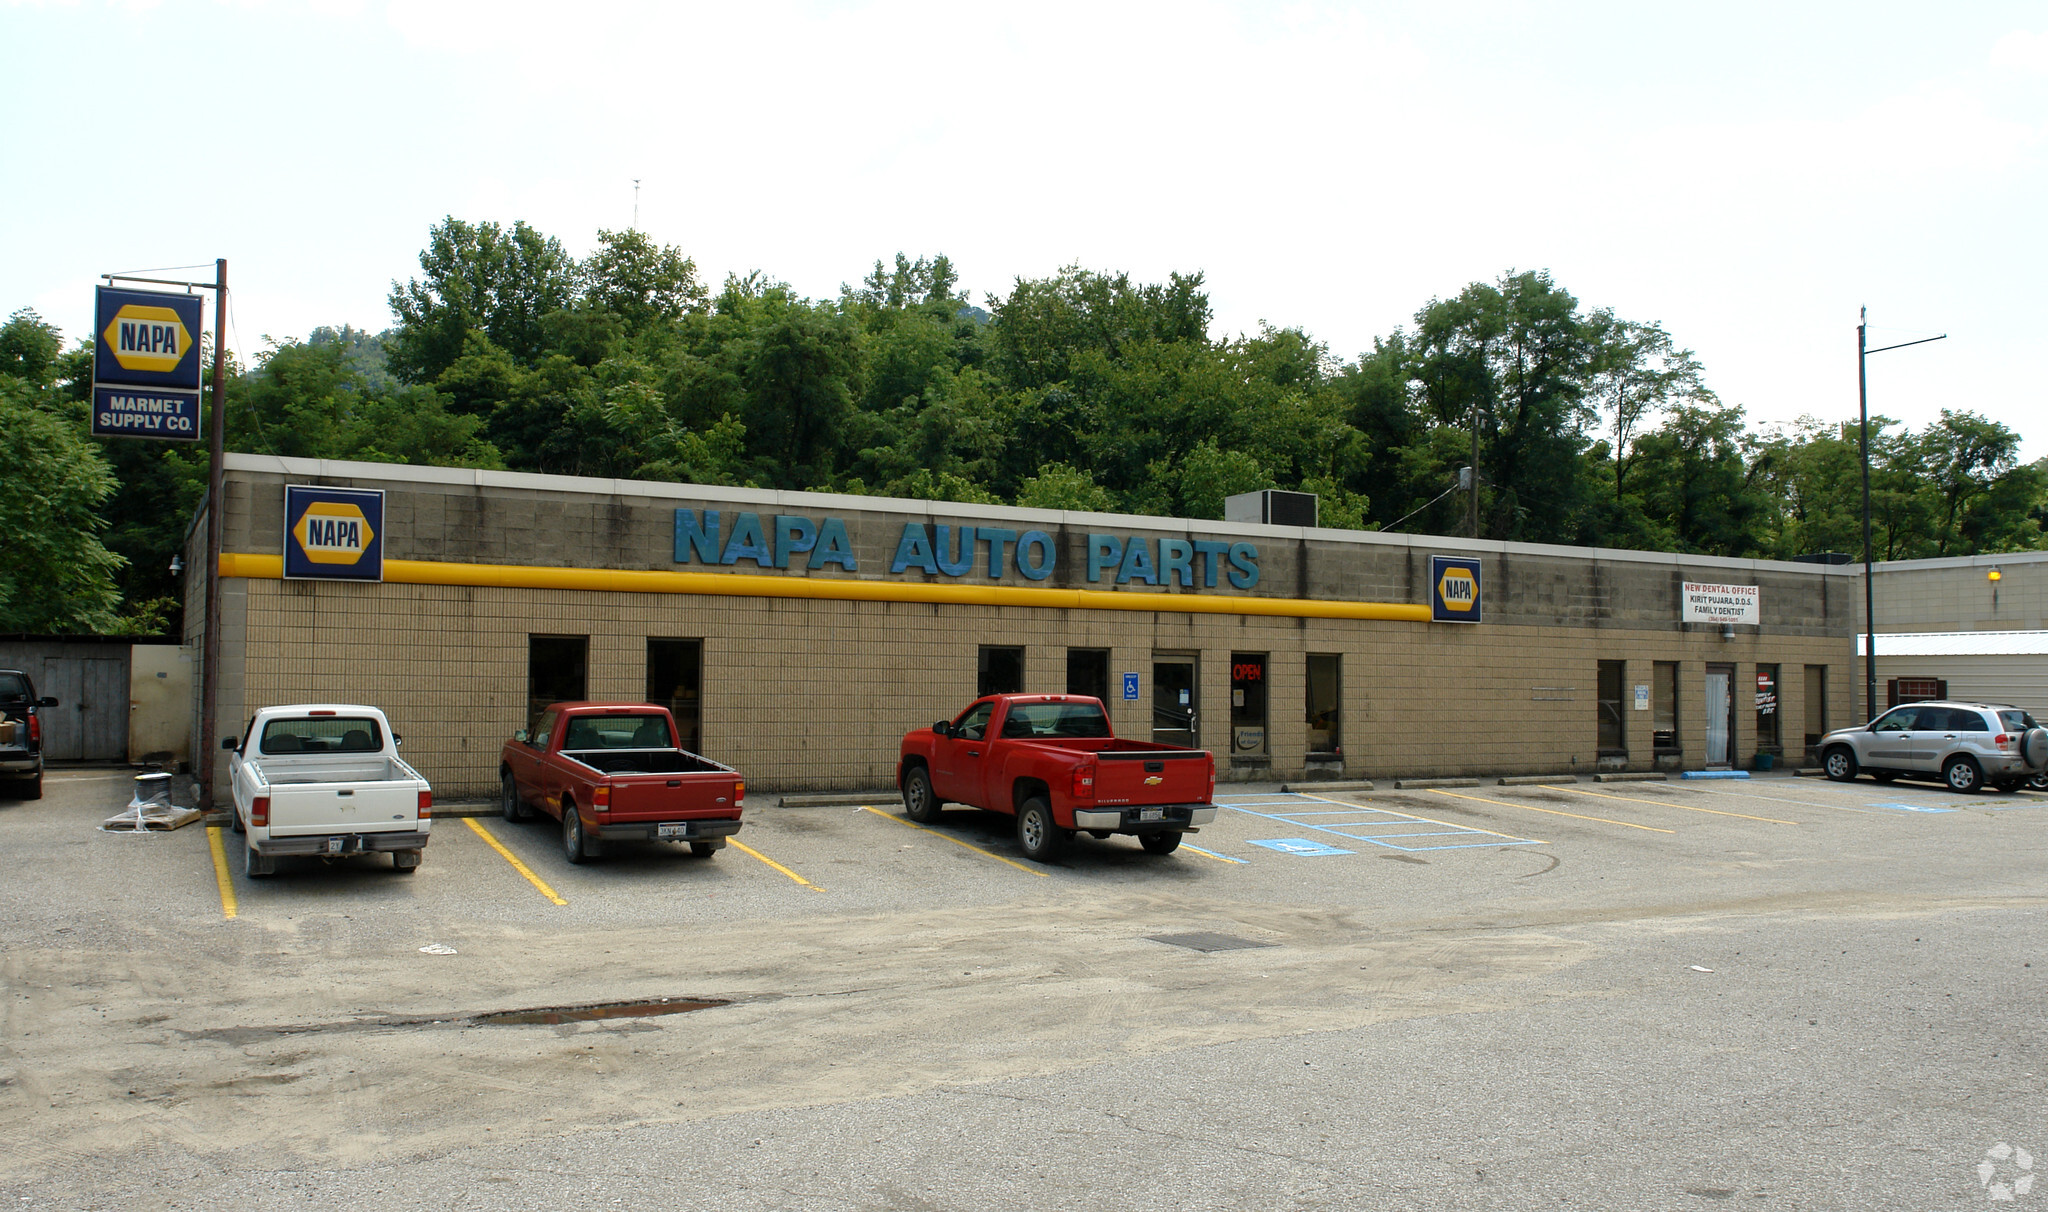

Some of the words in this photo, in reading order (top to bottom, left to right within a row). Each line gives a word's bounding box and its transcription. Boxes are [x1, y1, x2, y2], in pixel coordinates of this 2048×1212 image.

[121, 322, 177, 354] NAPA
[110, 396, 184, 414] MARMET
[100, 413, 162, 430] SUPPLY
[166, 416, 192, 431] CO.
[309, 519, 360, 548] NAPA
[673, 508, 858, 572] NAPA
[890, 522, 1057, 582] AUTO
[1087, 533, 1260, 590] PARTS
[1445, 579, 1471, 600] NAPA
[1684, 583, 1701, 592] NEW
[1702, 585, 1730, 594] DENTAL
[1731, 586, 1757, 596] OFFICE
[1689, 595, 1707, 604] KIRIT
[1708, 596, 1735, 606] PUJARA,
[1735, 597, 1753, 606] D.D.S.
[1694, 605, 1718, 614] FAMILY
[1718, 607, 1745, 616] DENTIST
[1232, 663, 1261, 681] OPEN
